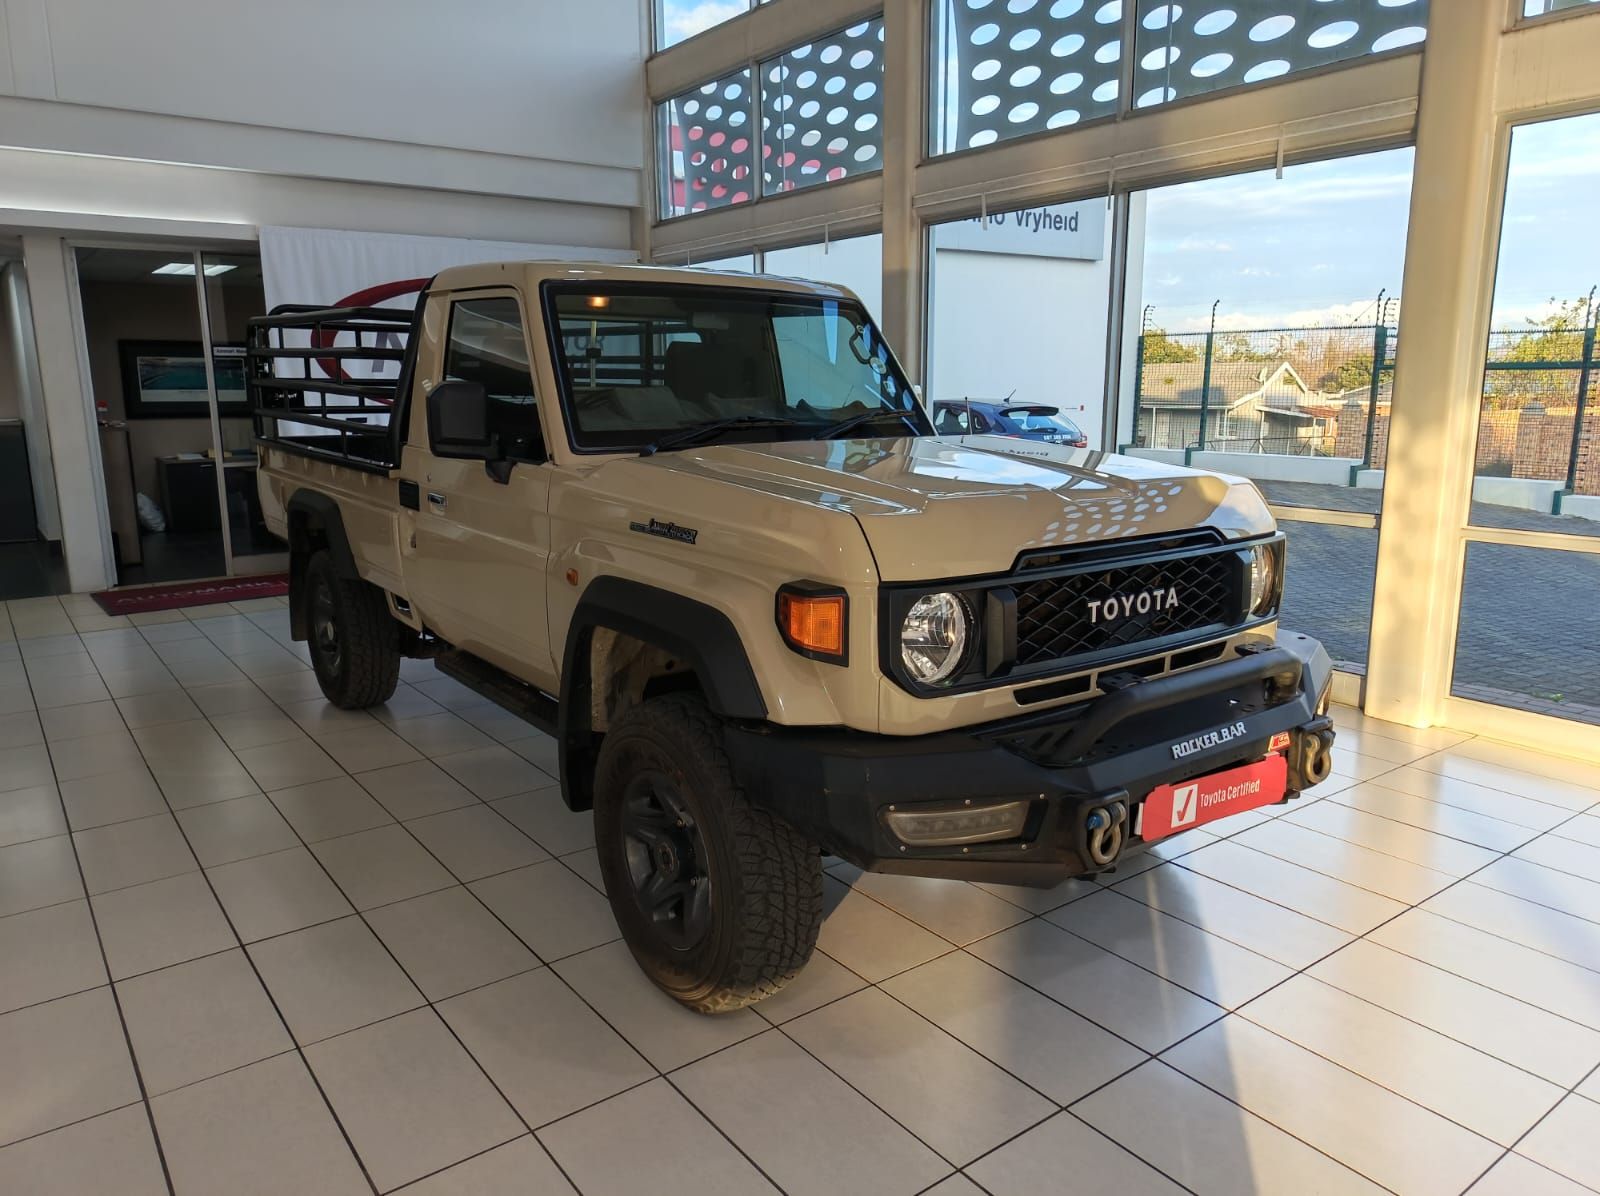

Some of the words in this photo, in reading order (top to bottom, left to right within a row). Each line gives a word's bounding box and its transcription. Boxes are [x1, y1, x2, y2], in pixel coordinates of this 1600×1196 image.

[1015, 208, 1079, 233] Vryheid
[1087, 587, 1179, 623] TOYOTA
[1172, 731, 1219, 759] ROCKER
[1220, 721, 1247, 742] BAR
[1200, 789, 1226, 808] Toyota
[1227, 779, 1261, 801] Certified
